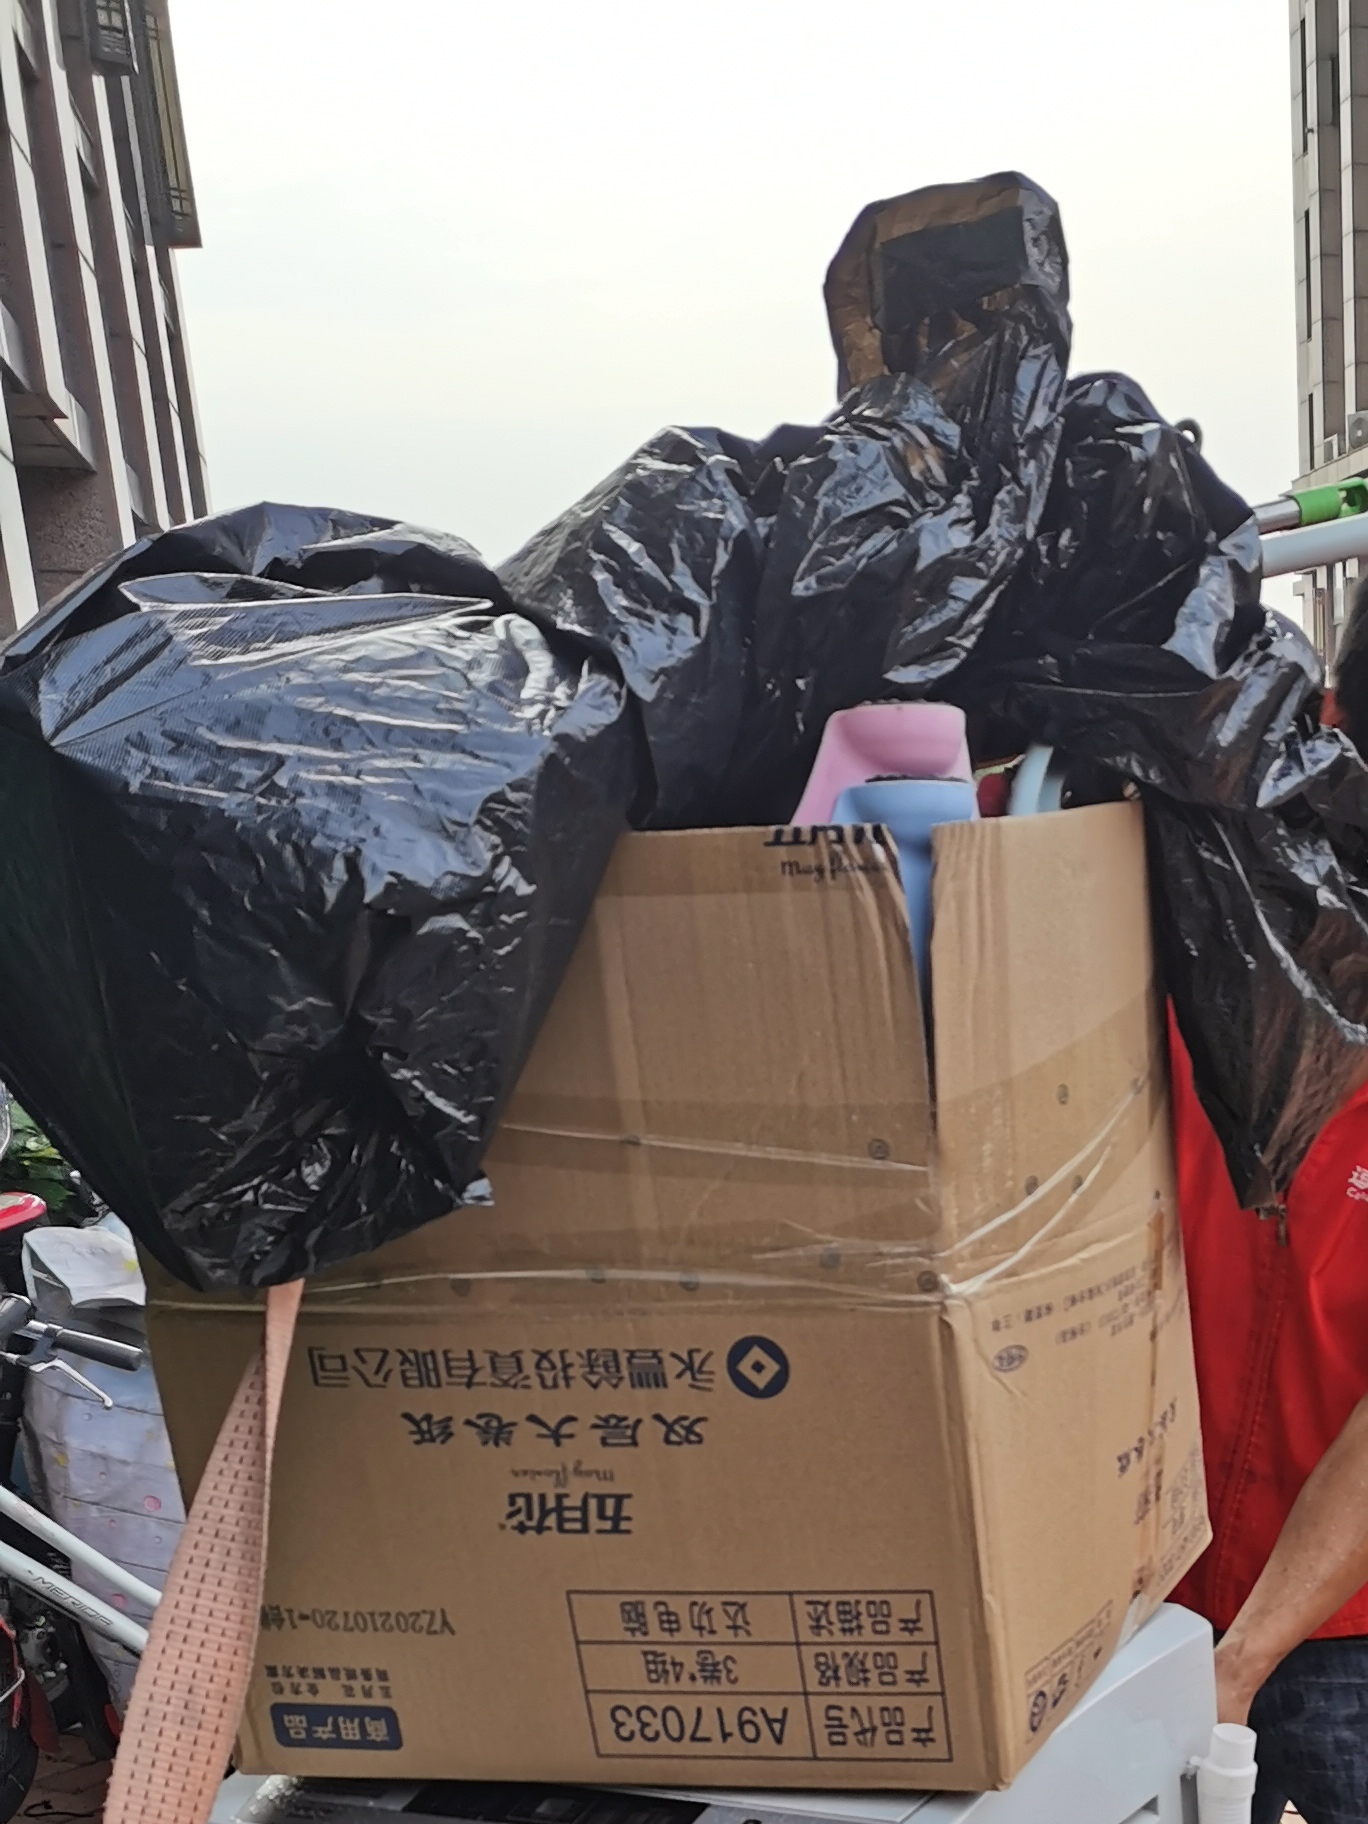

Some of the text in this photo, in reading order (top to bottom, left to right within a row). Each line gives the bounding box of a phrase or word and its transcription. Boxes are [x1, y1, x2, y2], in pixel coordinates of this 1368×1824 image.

[307, 1346, 715, 1392] 永豐餘投資有限公司
[401, 1412, 709, 1448] 双层大卷纸
[504, 1491, 634, 1536] 五月花
[619, 1599, 925, 1639] 产品描述 达功电脑
[813, 1650, 931, 1689] 产品规格
[282, 1713, 391, 1742] 商用产品
[609, 1703, 938, 1749] 产品代号 A917033
